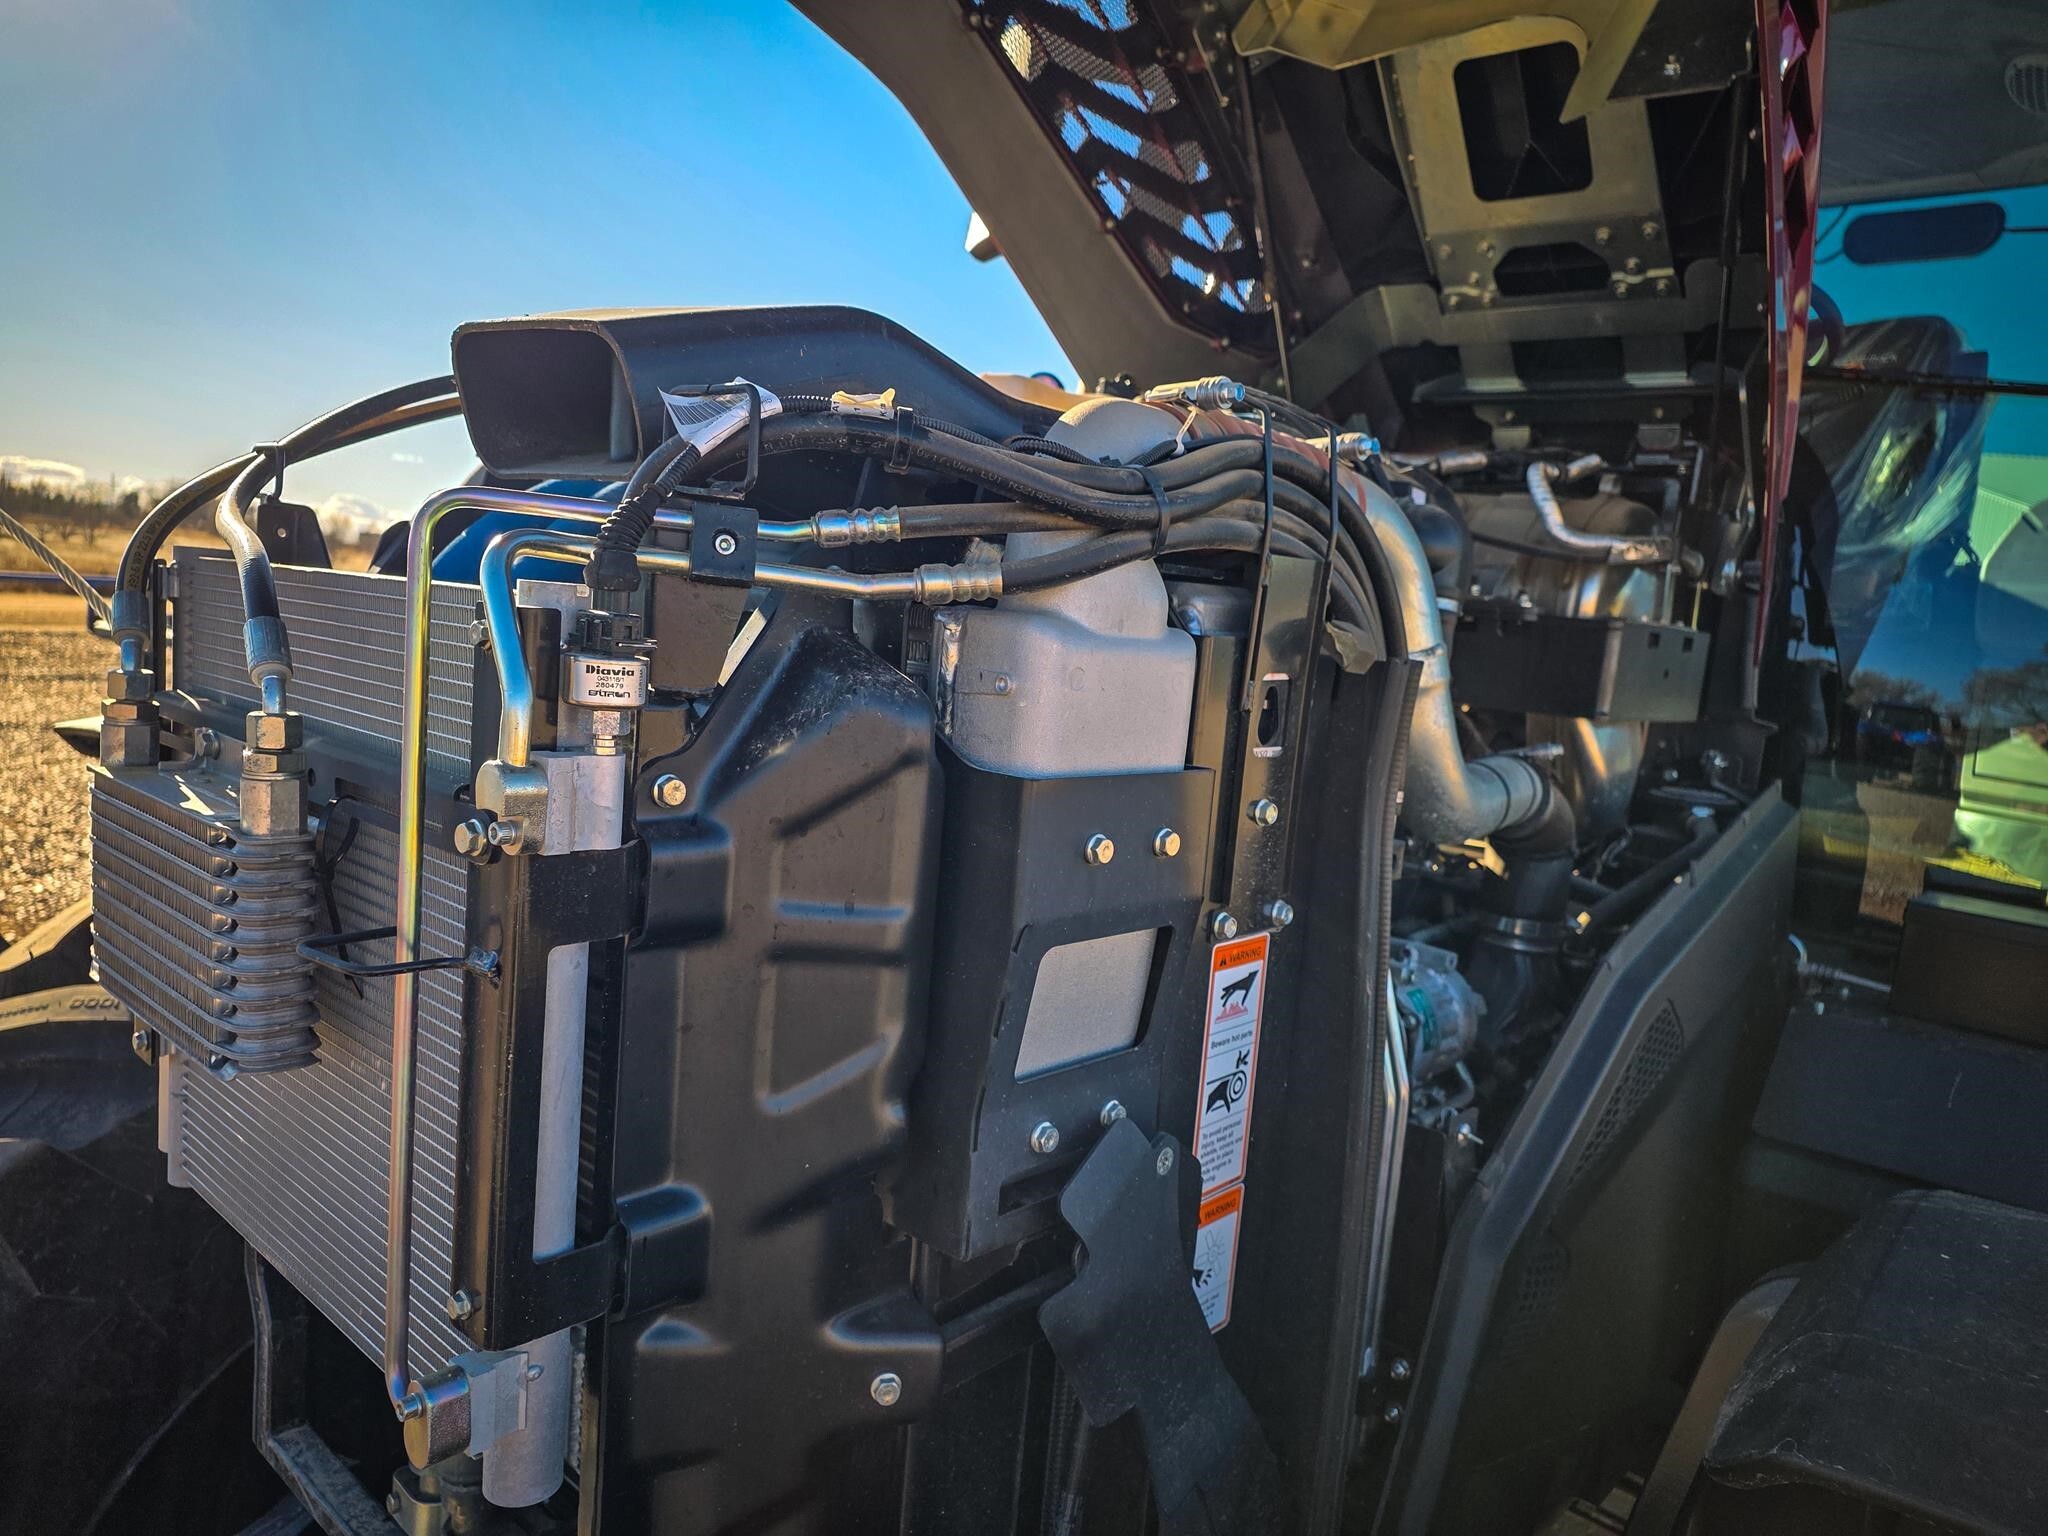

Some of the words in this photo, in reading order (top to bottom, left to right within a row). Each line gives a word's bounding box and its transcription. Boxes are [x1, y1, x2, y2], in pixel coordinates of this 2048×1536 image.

[586, 664, 635, 676] Diavia
[1229, 947, 1262, 963] WARNING
[1204, 1198, 1237, 1219] WARNING
